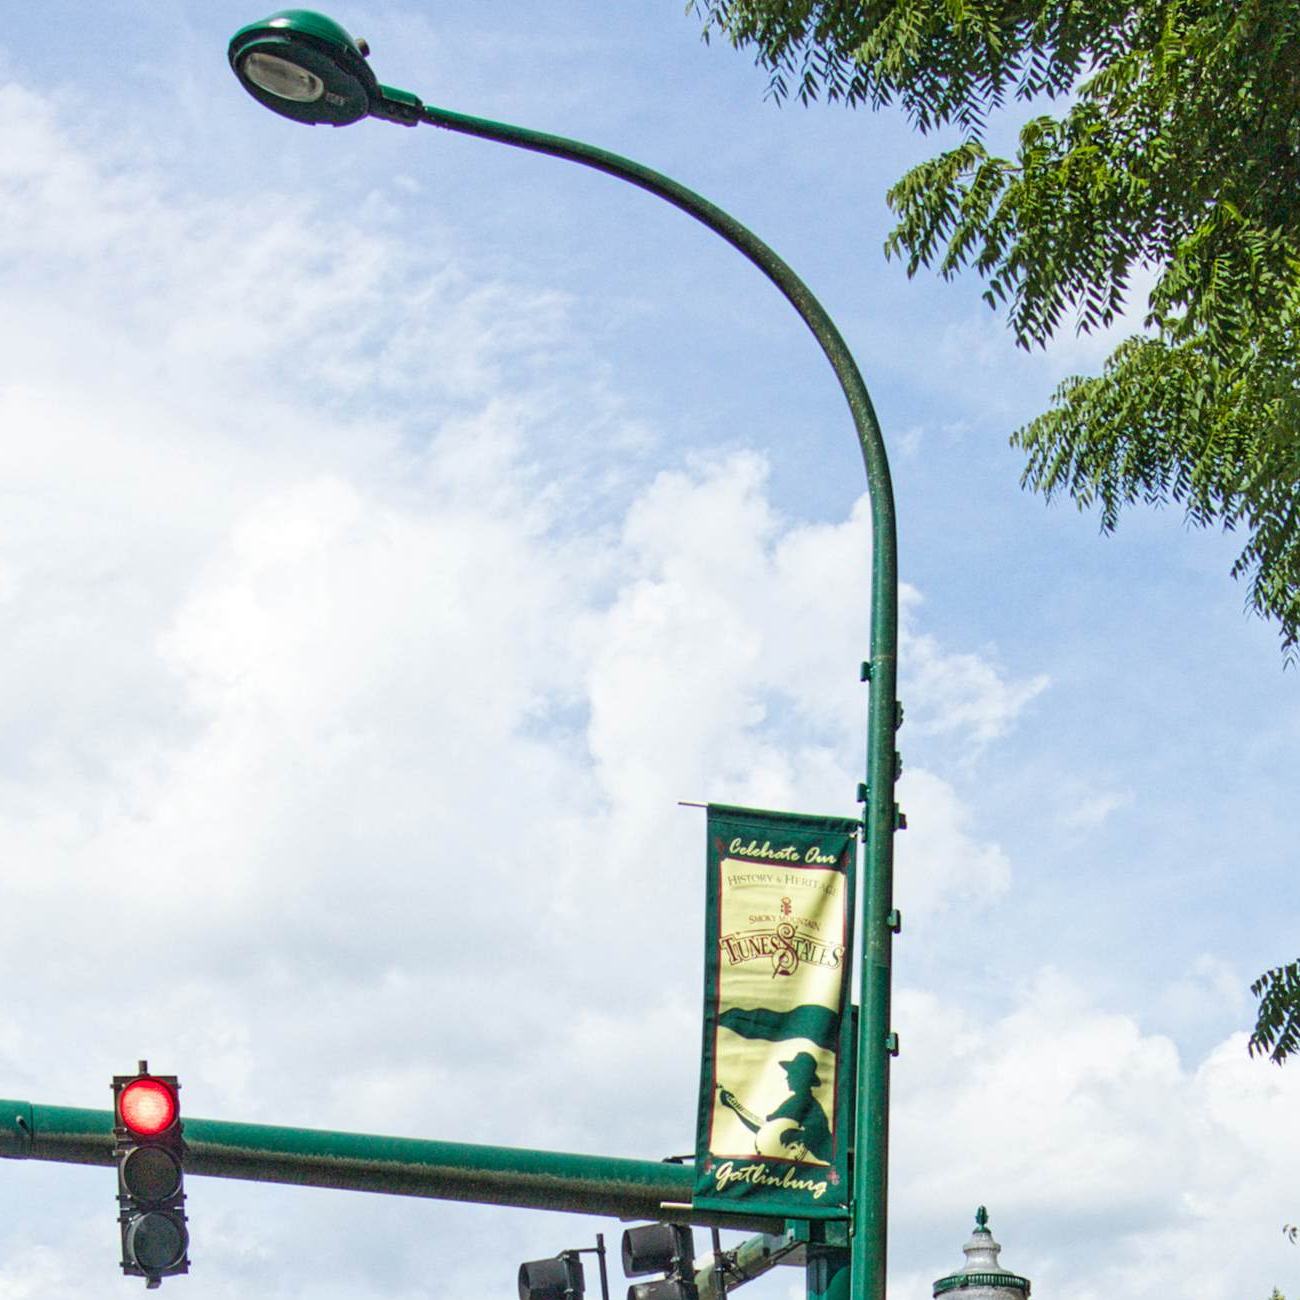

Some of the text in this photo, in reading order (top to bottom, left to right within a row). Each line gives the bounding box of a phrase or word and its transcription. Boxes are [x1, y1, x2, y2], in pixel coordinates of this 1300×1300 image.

[729, 838, 836, 864] Celebrate Our
[728, 873, 773, 886] HISTORY
[748, 915, 776, 925] SMOKY
[715, 1161, 827, 1199] Gatlinburg
